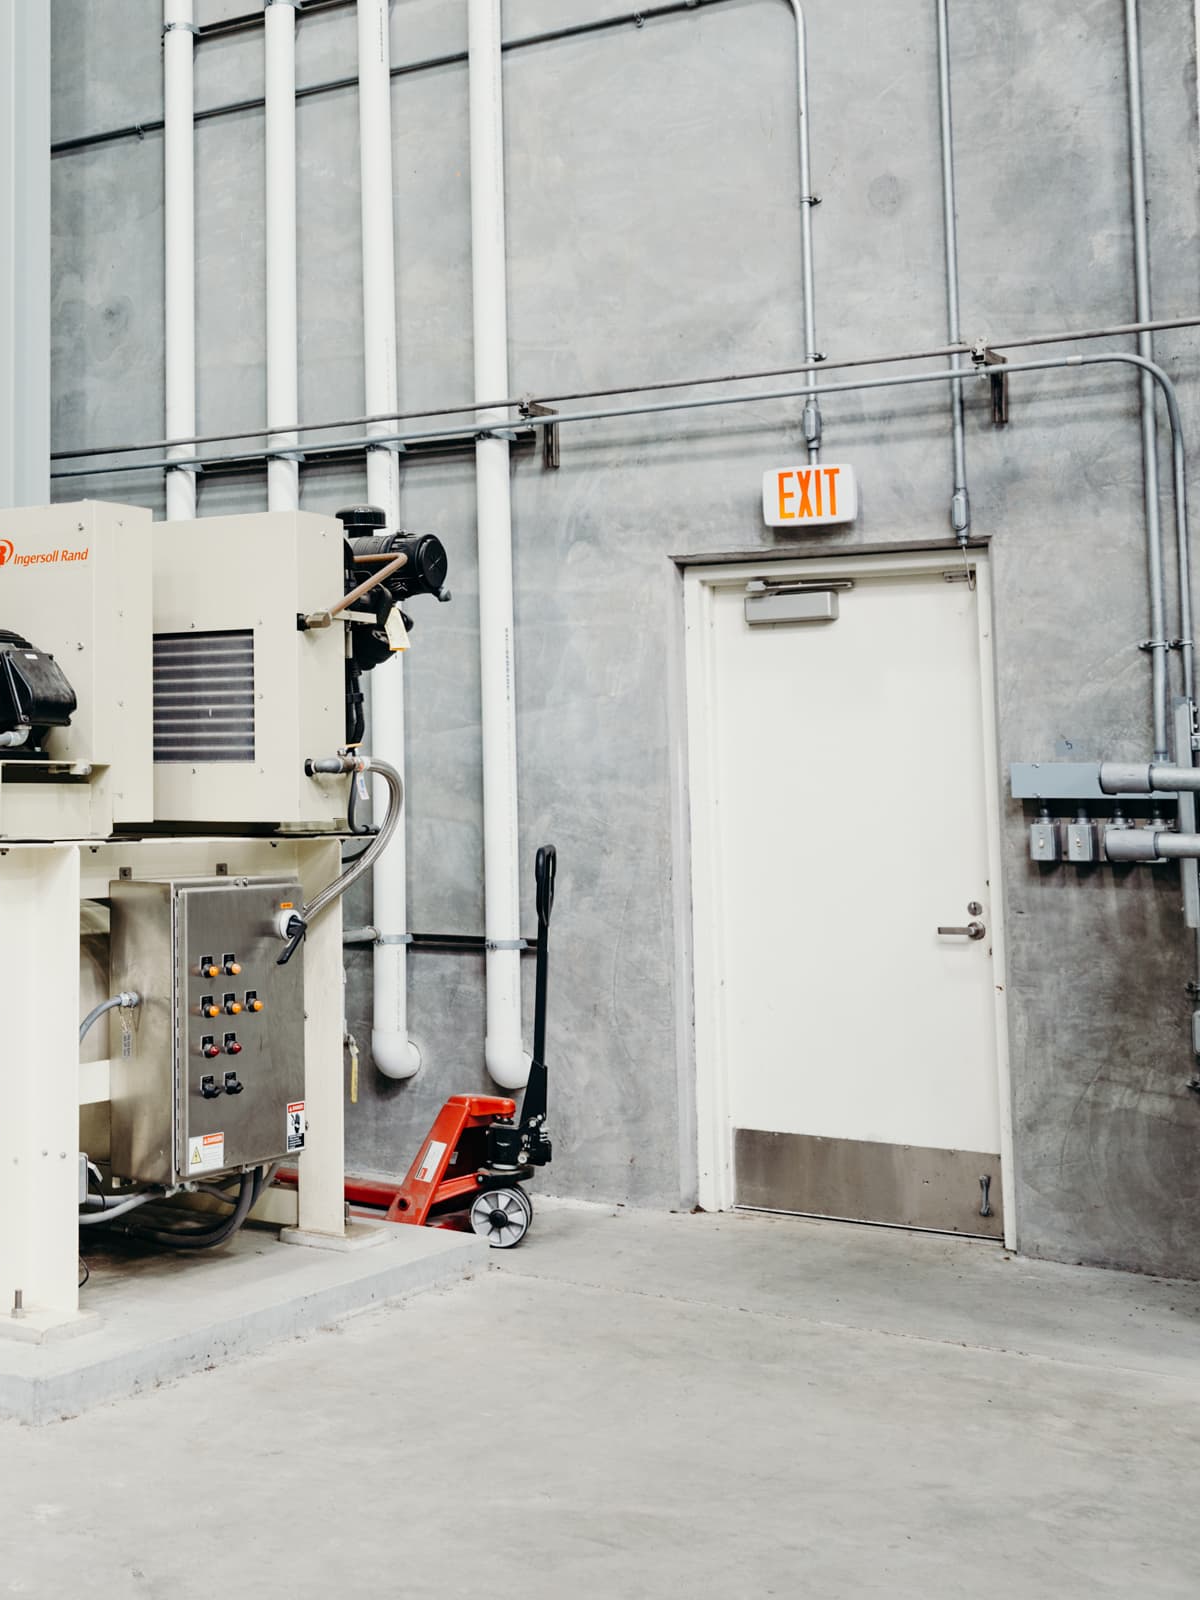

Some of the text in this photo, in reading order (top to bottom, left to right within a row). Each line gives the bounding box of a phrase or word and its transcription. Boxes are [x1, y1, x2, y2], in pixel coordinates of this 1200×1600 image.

[777, 468, 840, 519] EXIT
[14, 550, 59, 566] Ingersoll
[61, 548, 89, 561] Rand
